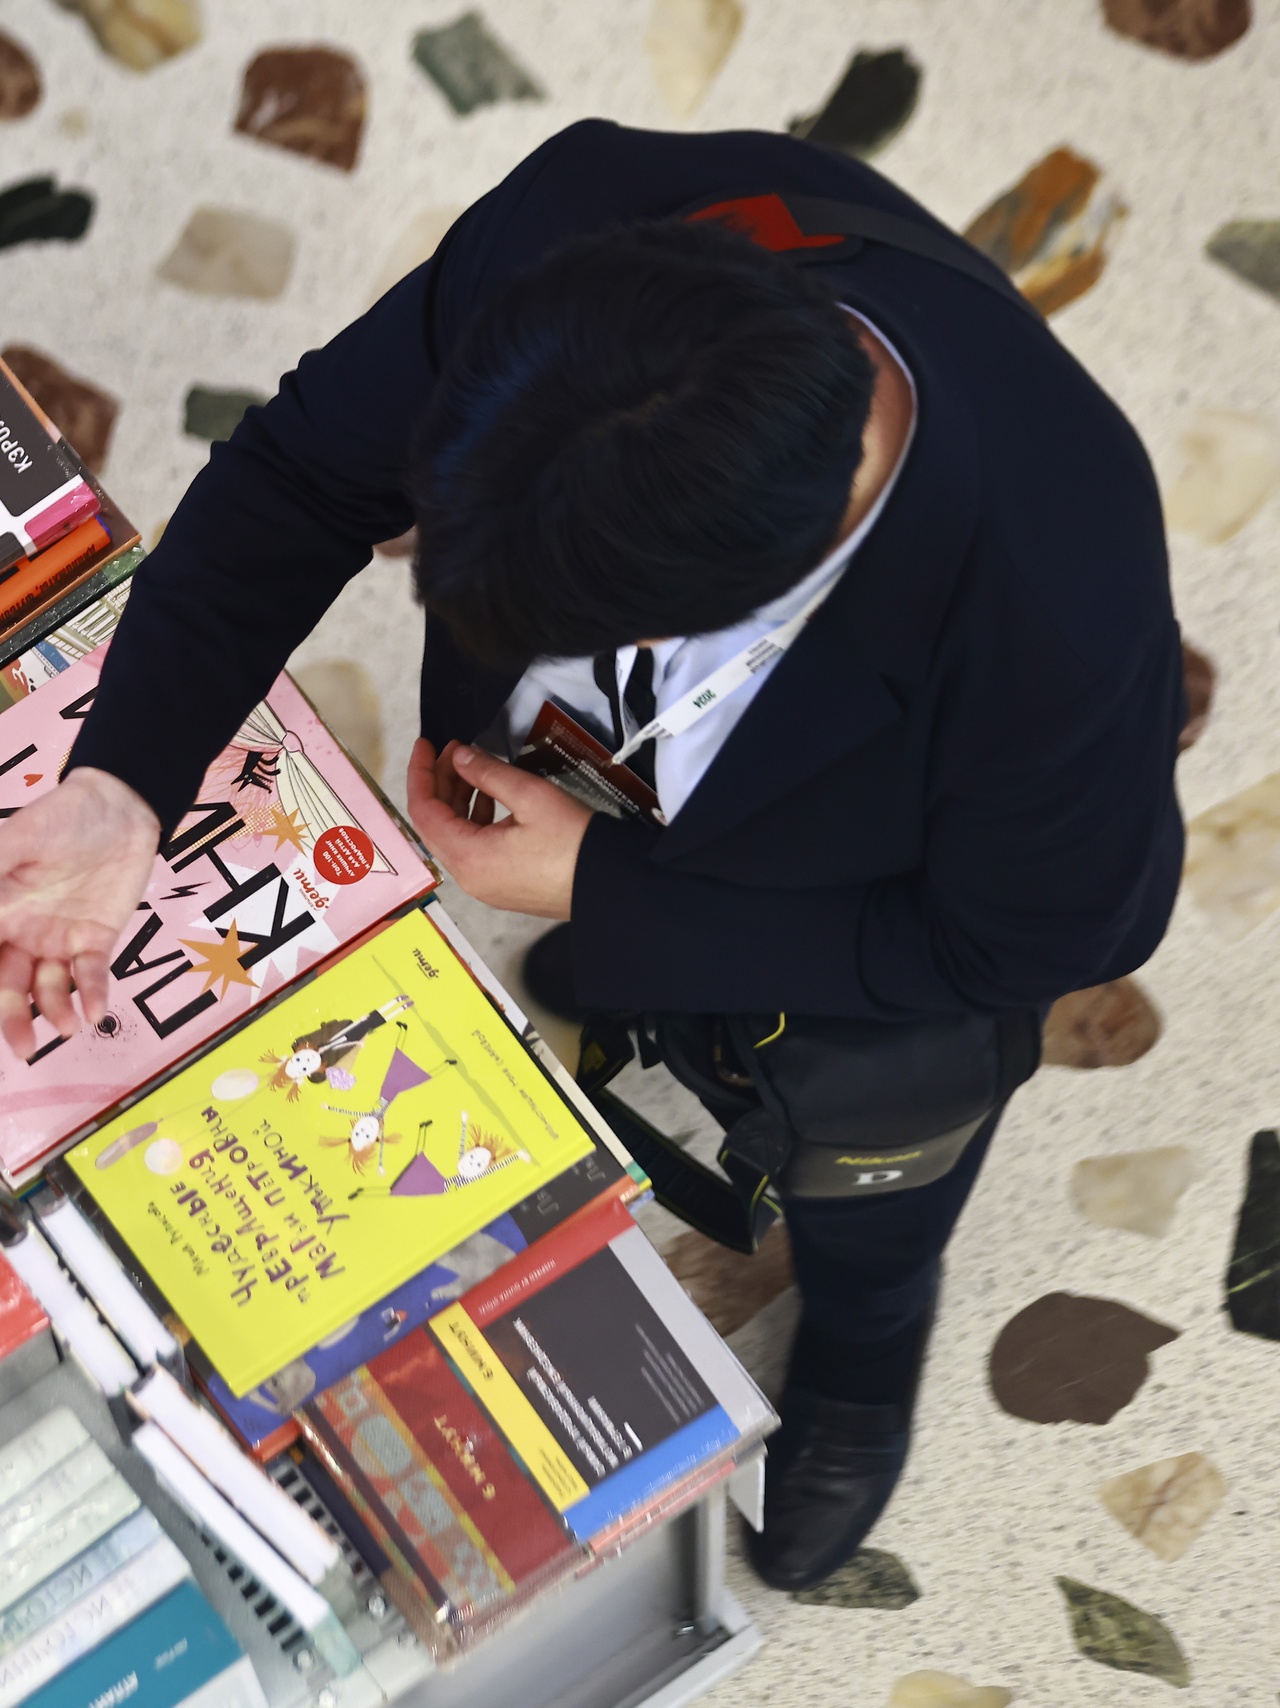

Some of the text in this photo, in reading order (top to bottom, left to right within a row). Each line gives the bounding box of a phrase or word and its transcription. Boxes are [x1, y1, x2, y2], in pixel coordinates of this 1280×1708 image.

[693, 688, 717, 710] 2024
[322, 850, 342, 876] Топ-100
[334, 837, 359, 868] ДЛЯ ДЕТЕЙ
[337, 827, 367, 864] ПОДРОСТКОВ
[447, 1319, 487, 1371] МИНУТ
[511, 1317, 563, 1383] ЕЖЕДНЕВНИК
[432, 1412, 487, 1484] МИНУТ
